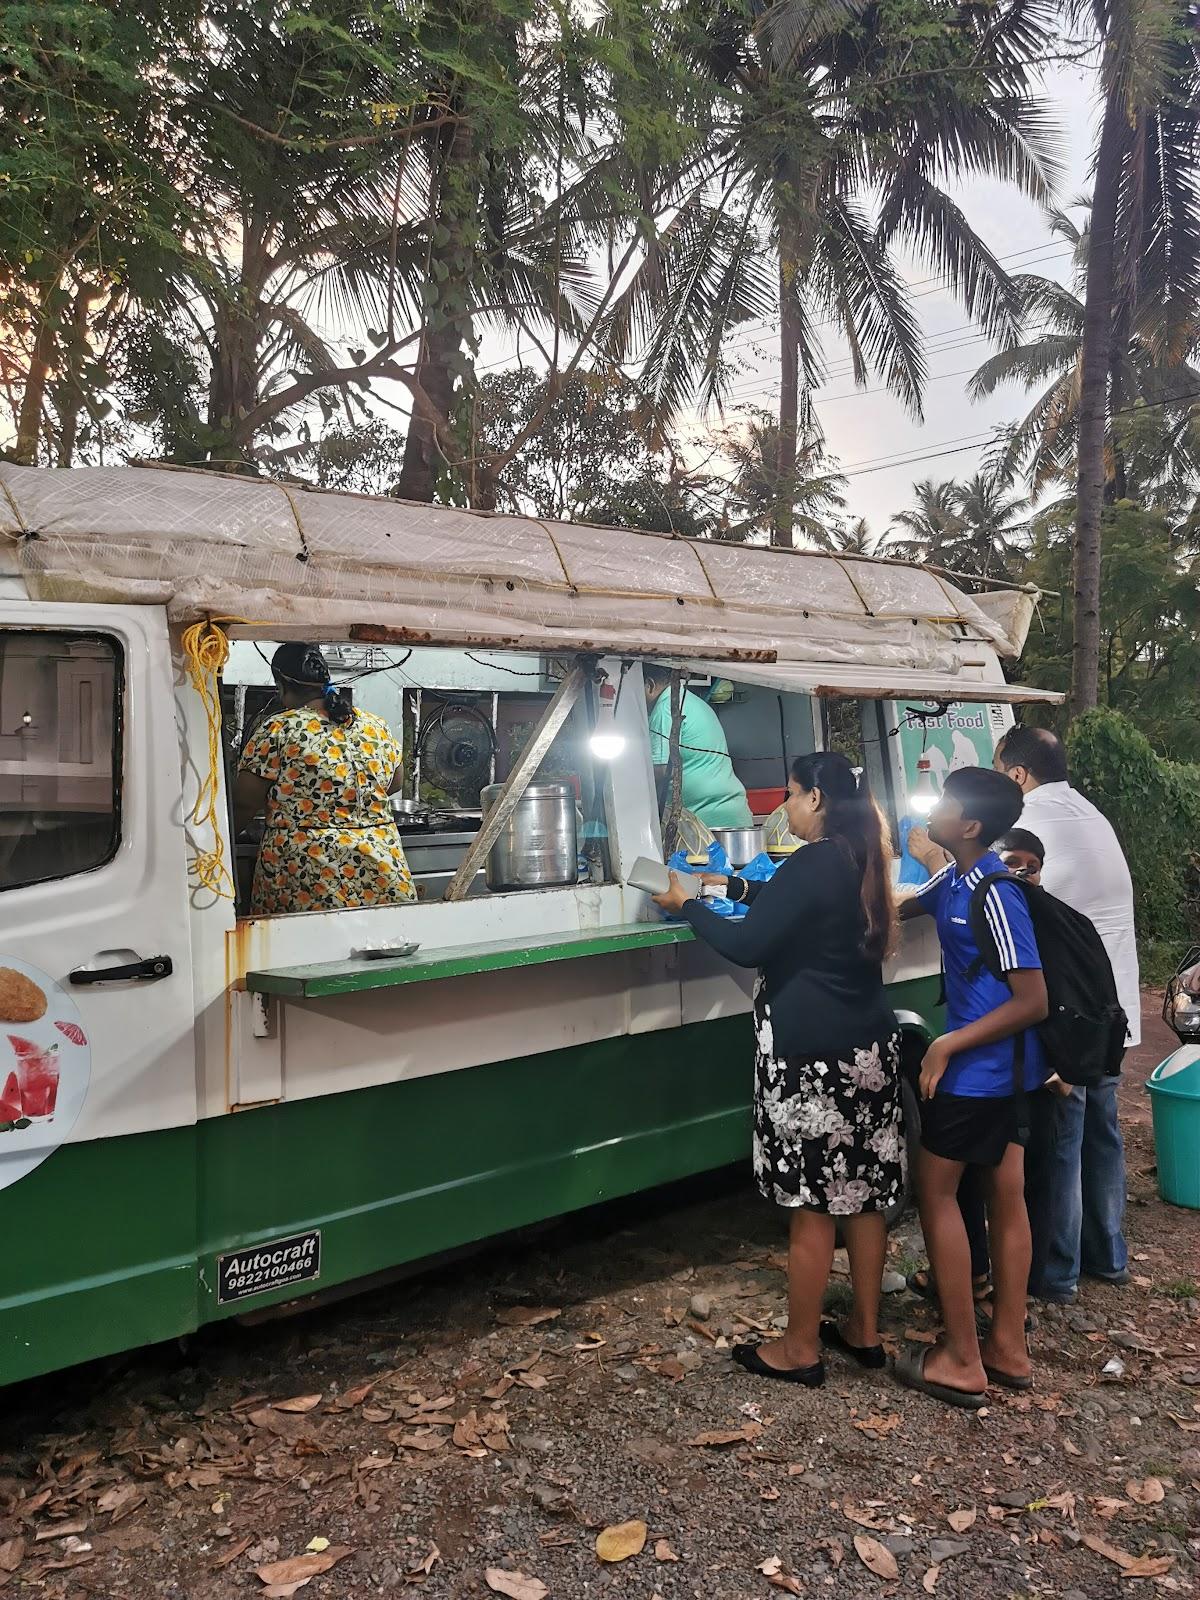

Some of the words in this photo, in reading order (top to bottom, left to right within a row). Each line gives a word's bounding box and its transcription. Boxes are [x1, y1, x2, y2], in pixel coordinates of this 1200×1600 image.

[904, 711, 943, 729] Fast
[946, 710, 985, 729] Food
[225, 1238, 316, 1278] Autocraft
[228, 1257, 312, 1290] 9822100466
